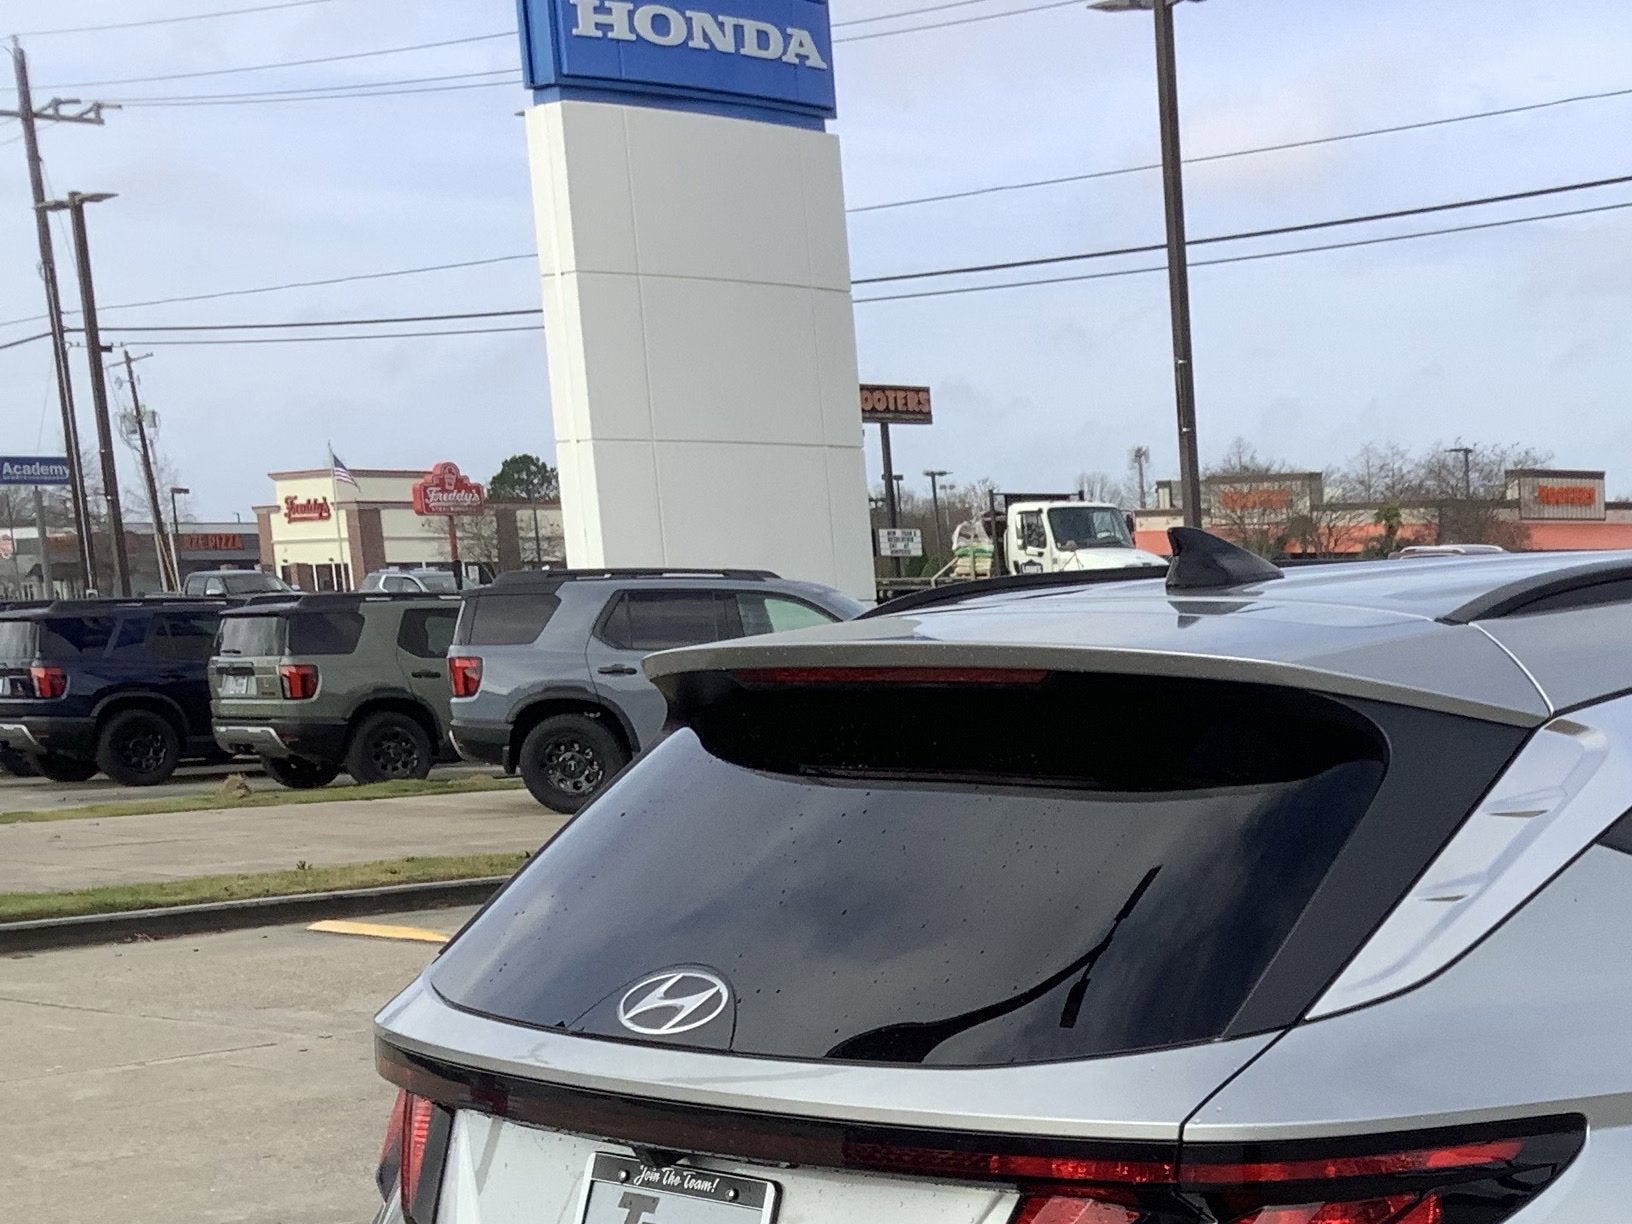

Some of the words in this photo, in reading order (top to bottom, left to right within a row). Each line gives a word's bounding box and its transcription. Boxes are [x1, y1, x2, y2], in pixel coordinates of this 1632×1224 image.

[569, 0, 828, 71] HONDA
[861, 389, 930, 413] OOTERS
[3, 461, 70, 480] Academy
[426, 487, 481, 508] Freddy's
[634, 1165, 661, 1186] Join
[661, 1167, 682, 1186] The
[683, 1171, 721, 1193] Team!
